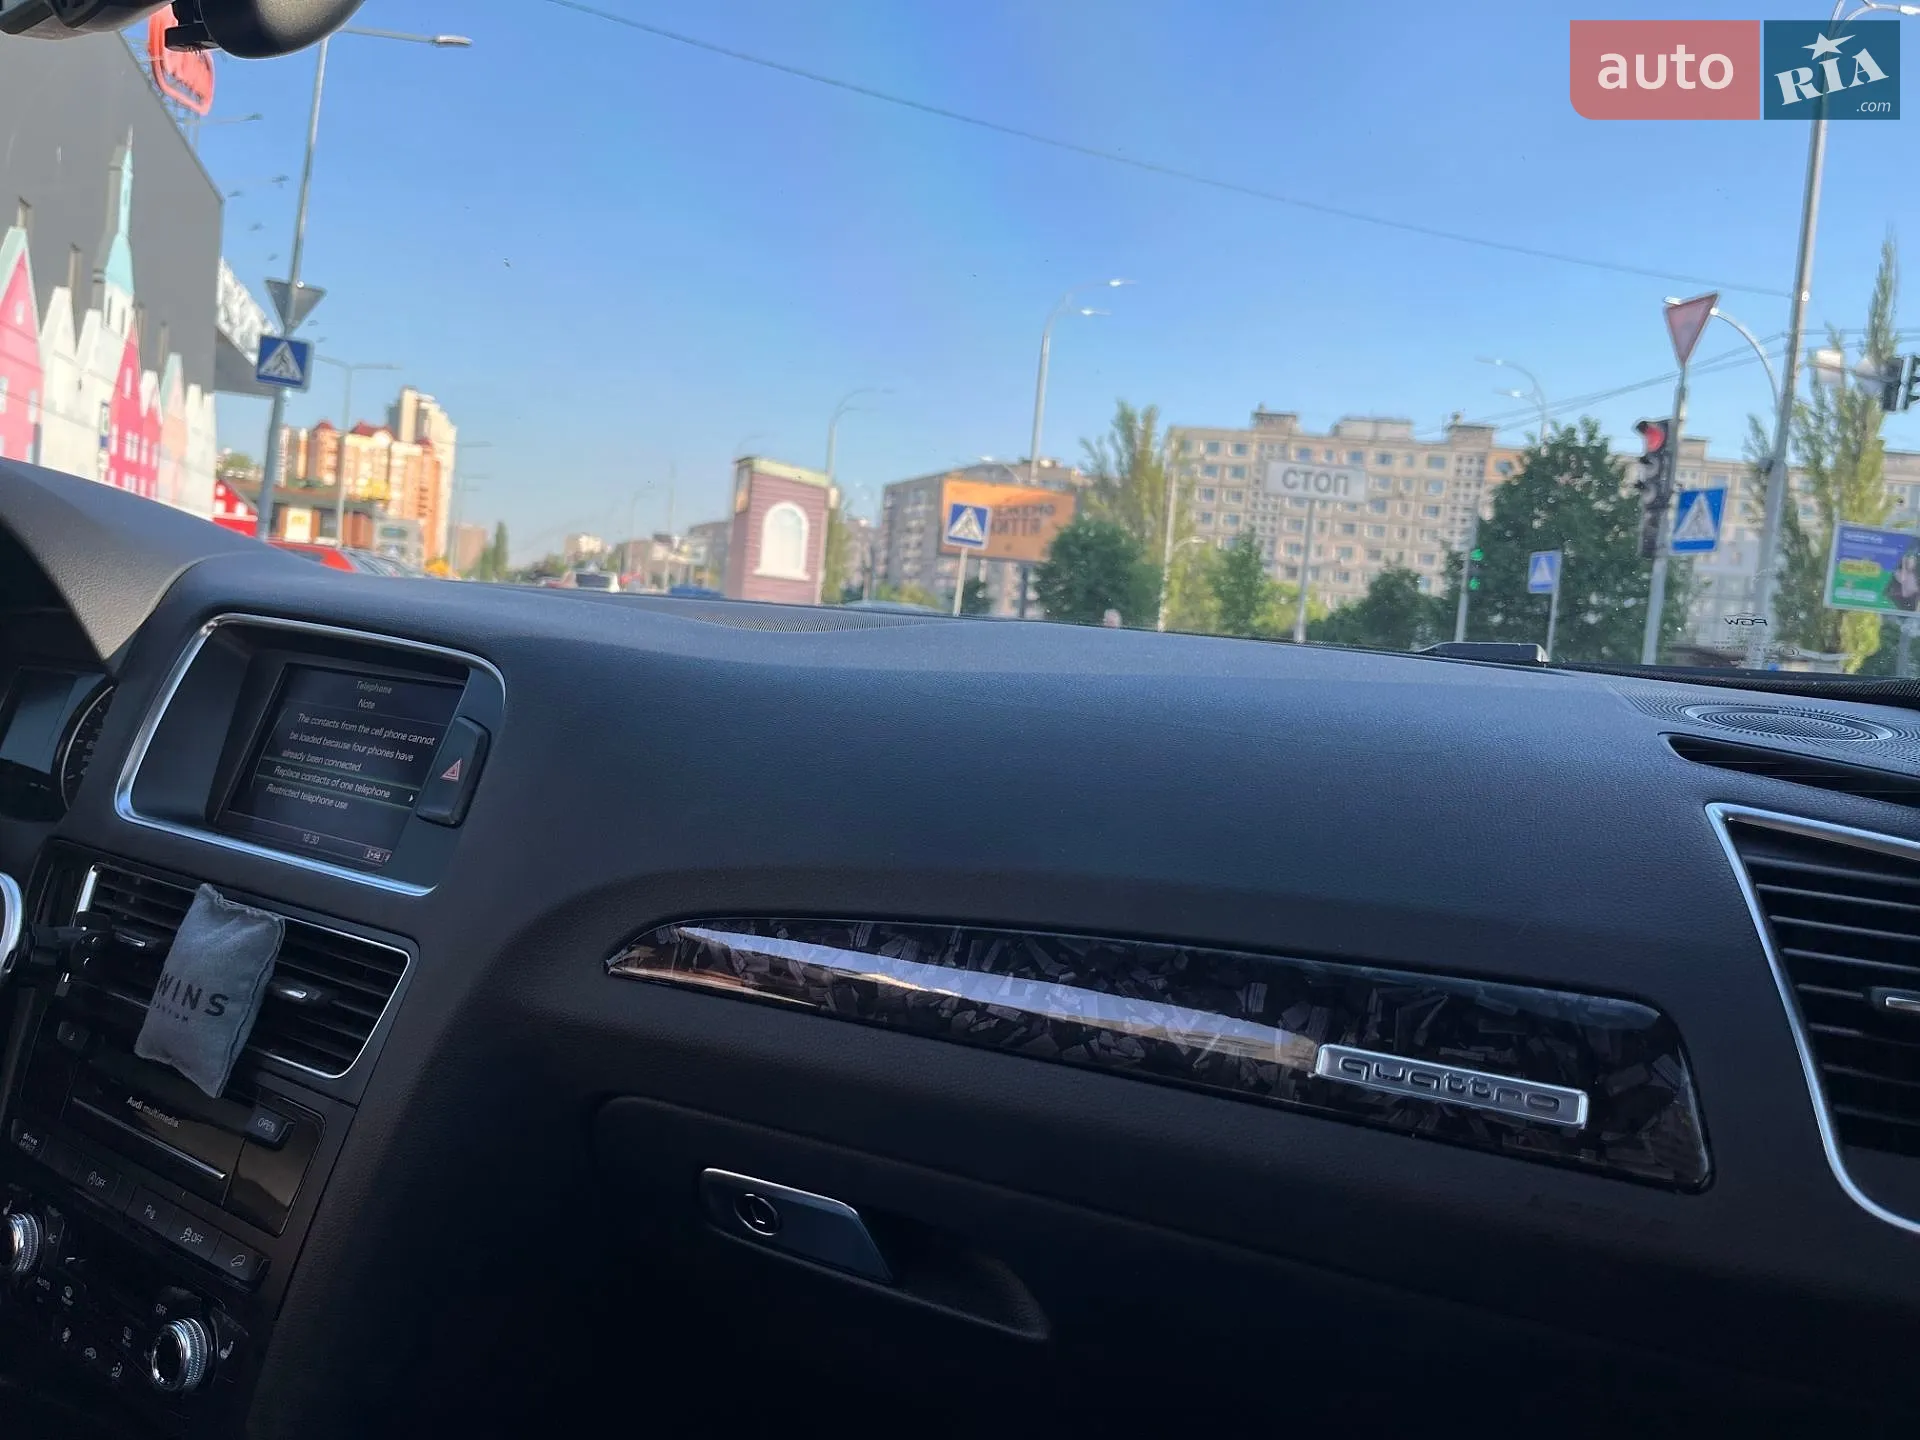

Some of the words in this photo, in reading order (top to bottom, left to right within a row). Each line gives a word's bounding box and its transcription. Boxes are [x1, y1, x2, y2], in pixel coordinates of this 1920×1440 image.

[1281, 466, 1350, 497] СТОП
[355, 680, 393, 695] Telephone
[357, 698, 376, 710] Note
[297, 712, 310, 724] The
[310, 716, 340, 729] contacts
[341, 720, 358, 732] from
[358, 724, 369, 735] the
[370, 726, 384, 738] cell
[383, 729, 407, 742] phone
[407, 733, 436, 746] cannot
[282, 749, 306, 762] already
[306, 752, 324, 764] been
[324, 756, 363, 772] connected
[289, 731, 299, 741] be
[299, 733, 323, 745] loaded
[322, 736, 351, 750] because
[351, 742, 368, 754] four
[367, 745, 395, 759] phones
[395, 749, 414, 762] have
[266, 783, 302, 799] Restricted
[300, 790, 335, 807] telephone
[334, 799, 349, 810] use
[274, 765, 301, 780] Replace
[301, 772, 331, 786] contacts
[331, 777, 340, 788] of
[340, 780, 353, 791] one
[354, 783, 391, 799] telephone
[1338, 1055, 1561, 1113] quattro
[125, 1095, 144, 1111] Audi
[142, 1104, 180, 1128] multimedia
[257, 1116, 276, 1134] OPEN
